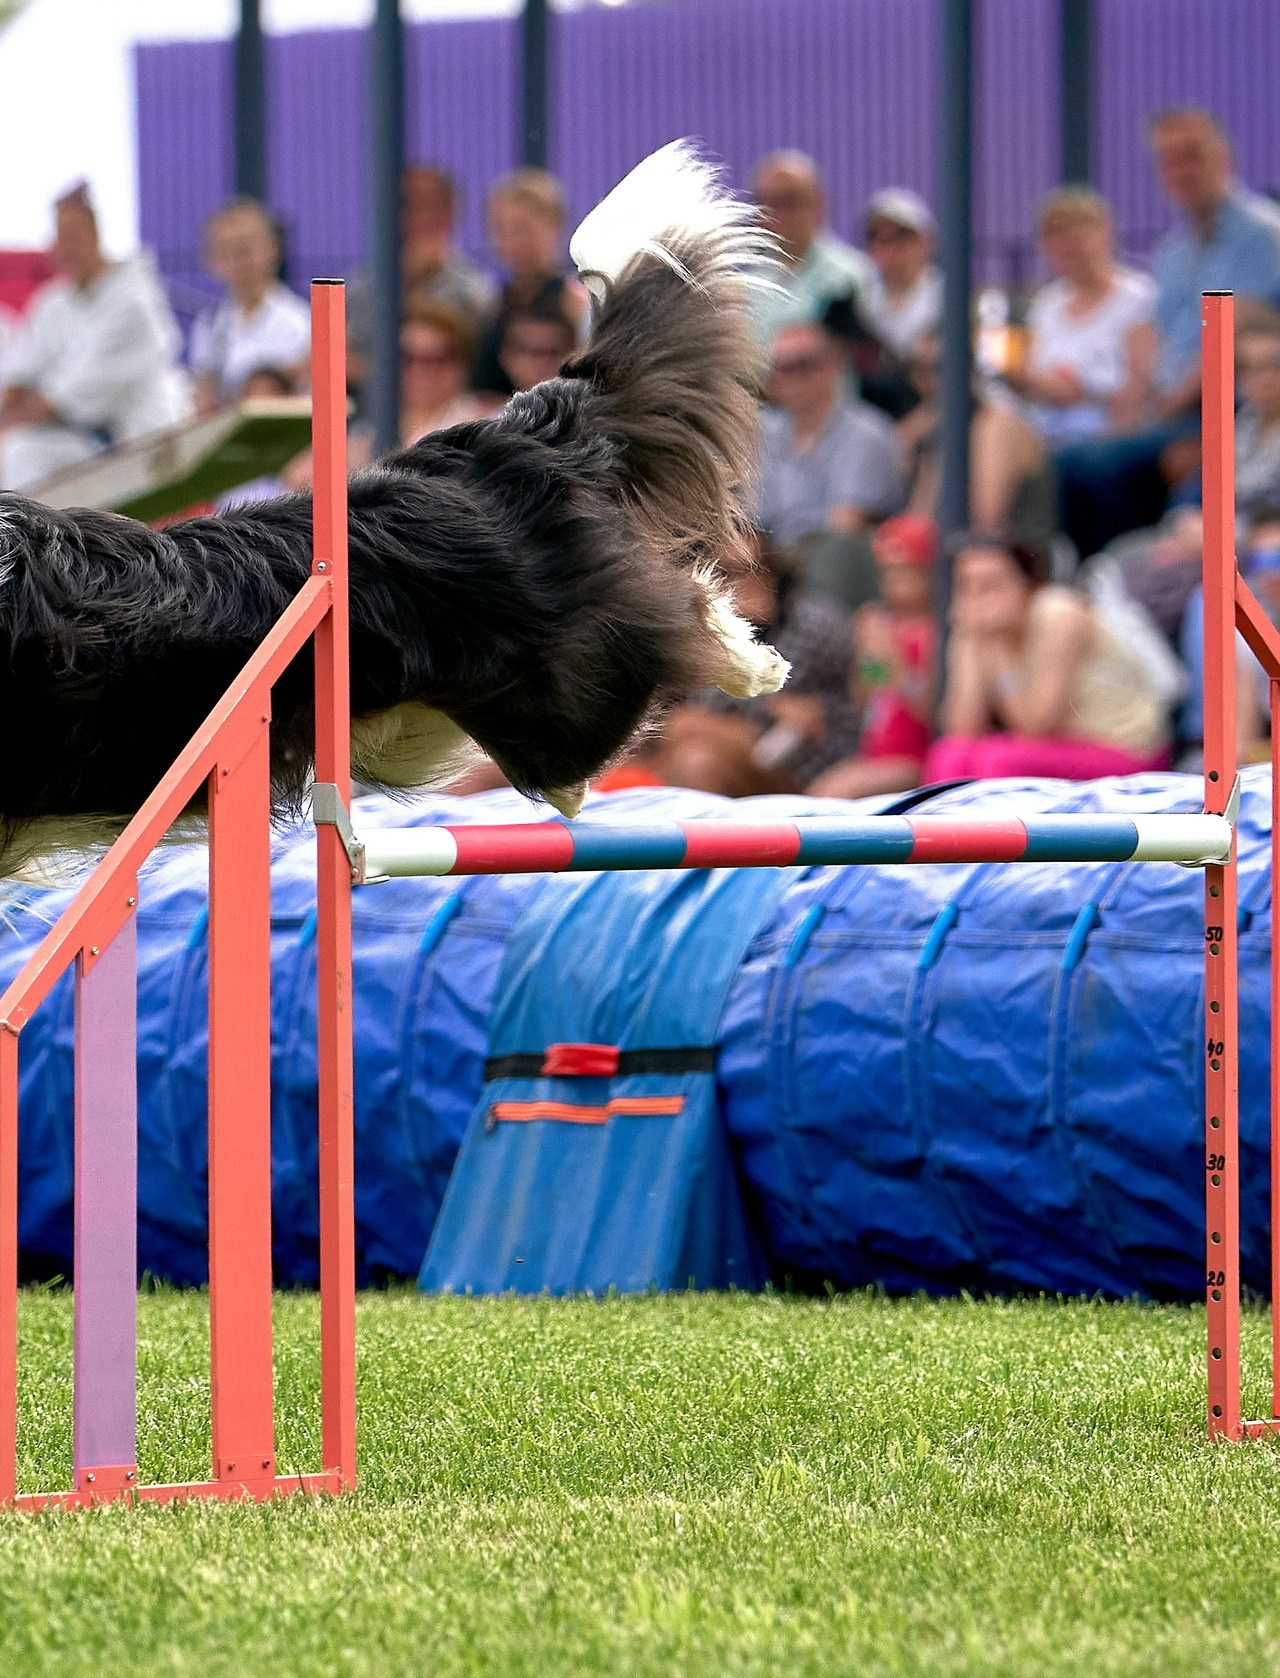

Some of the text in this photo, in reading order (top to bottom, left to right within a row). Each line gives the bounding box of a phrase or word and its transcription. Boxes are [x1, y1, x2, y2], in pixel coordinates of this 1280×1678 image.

[1205, 926, 1223, 941] 50
[1207, 1038, 1224, 1058] 40
[1206, 1153, 1225, 1170] 30
[1207, 1270, 1225, 1286] 20
